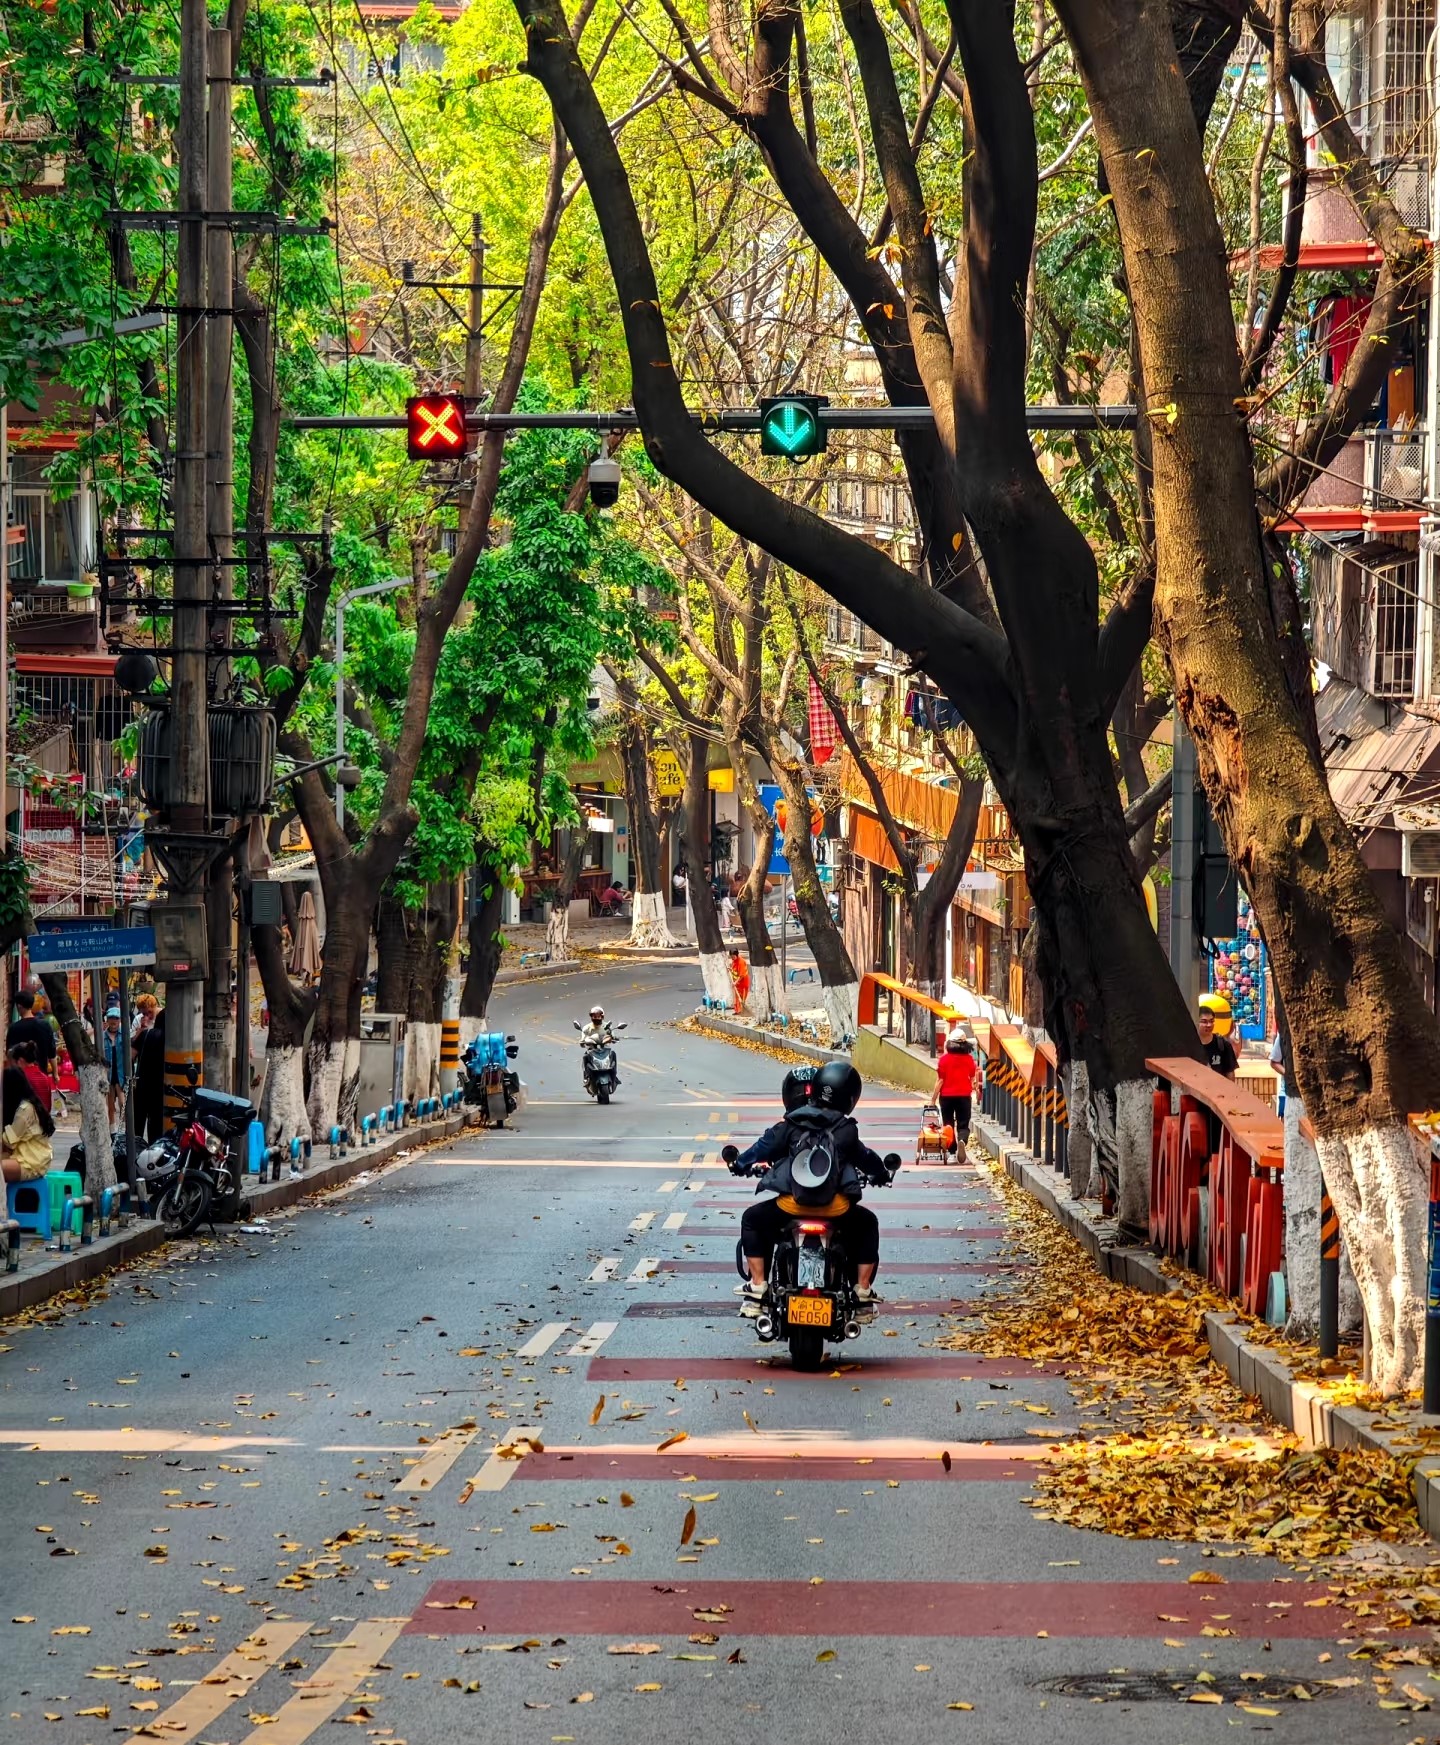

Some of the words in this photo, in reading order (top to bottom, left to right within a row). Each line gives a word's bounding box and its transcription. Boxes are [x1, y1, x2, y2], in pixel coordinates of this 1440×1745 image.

[659, 773, 681, 785] afé
[25, 829, 72, 842] WELCOME
[791, 1311, 829, 1325] NE050
